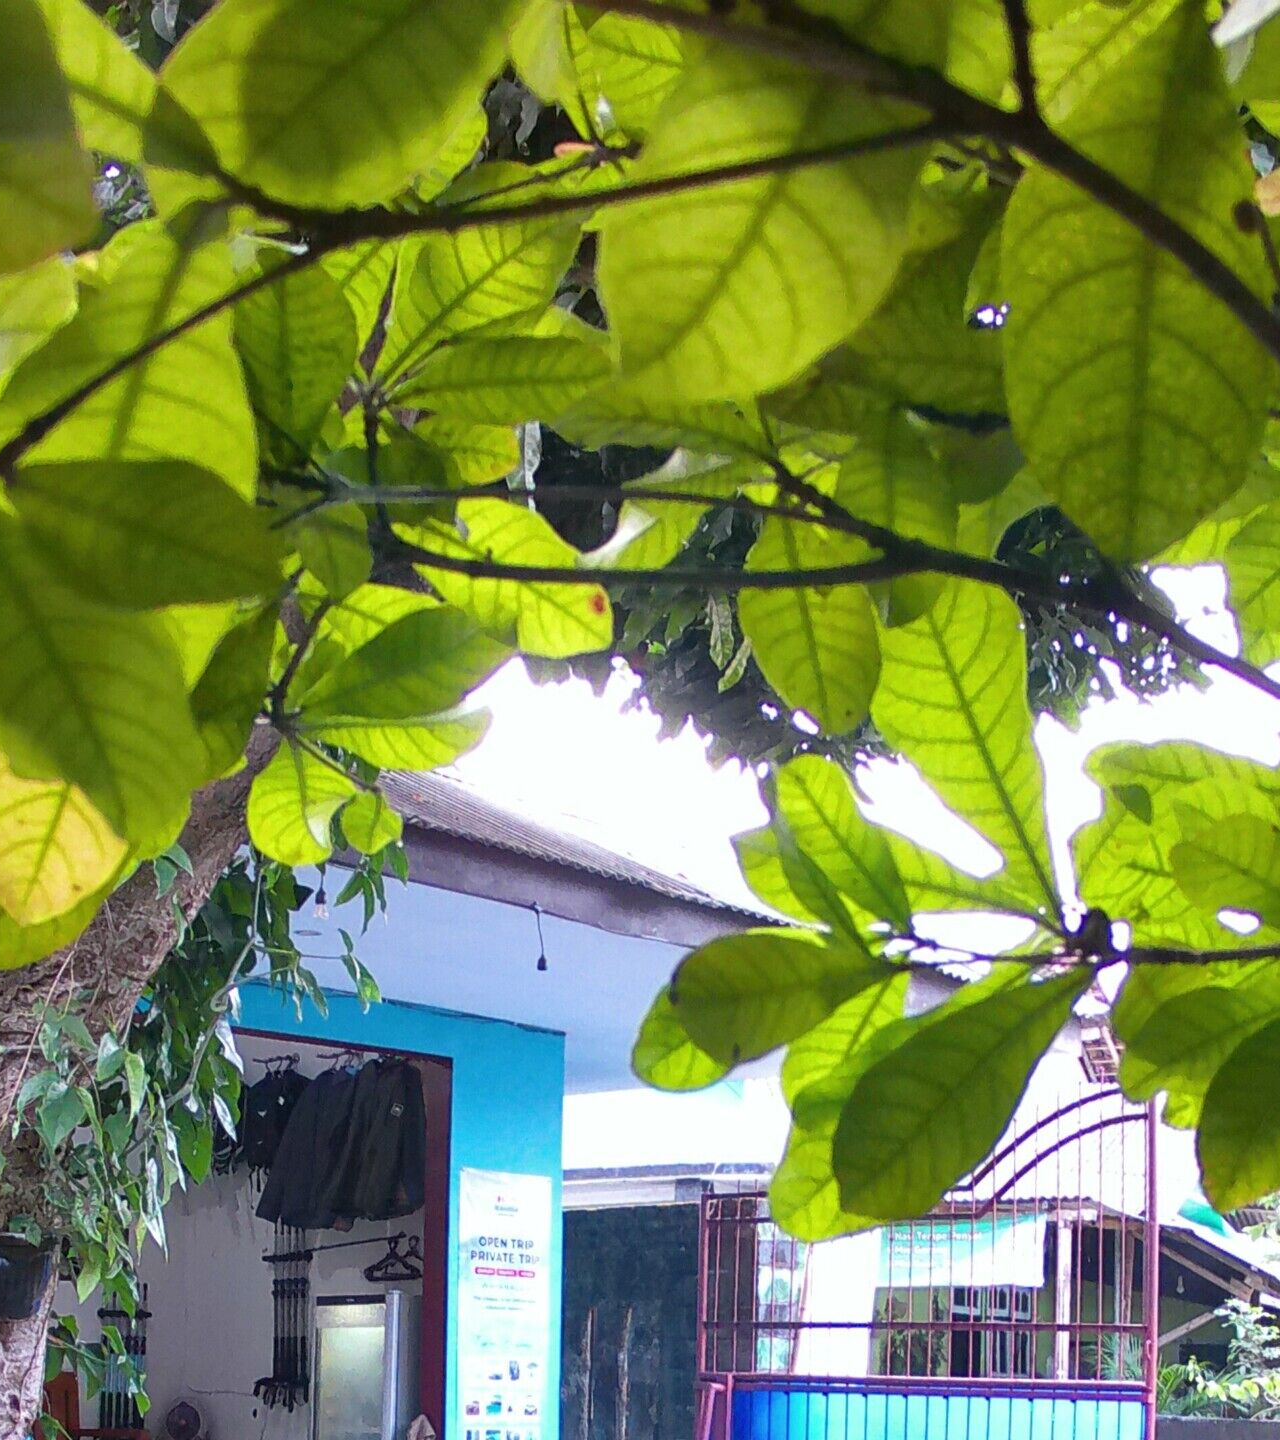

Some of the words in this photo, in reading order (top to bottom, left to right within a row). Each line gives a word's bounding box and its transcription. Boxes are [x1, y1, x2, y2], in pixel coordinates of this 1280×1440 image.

[478, 1235, 508, 1248] OPEN
[510, 1238, 535, 1251] TRIP
[470, 1250, 515, 1264] PRIVATE
[518, 1253, 540, 1265] TRIP
